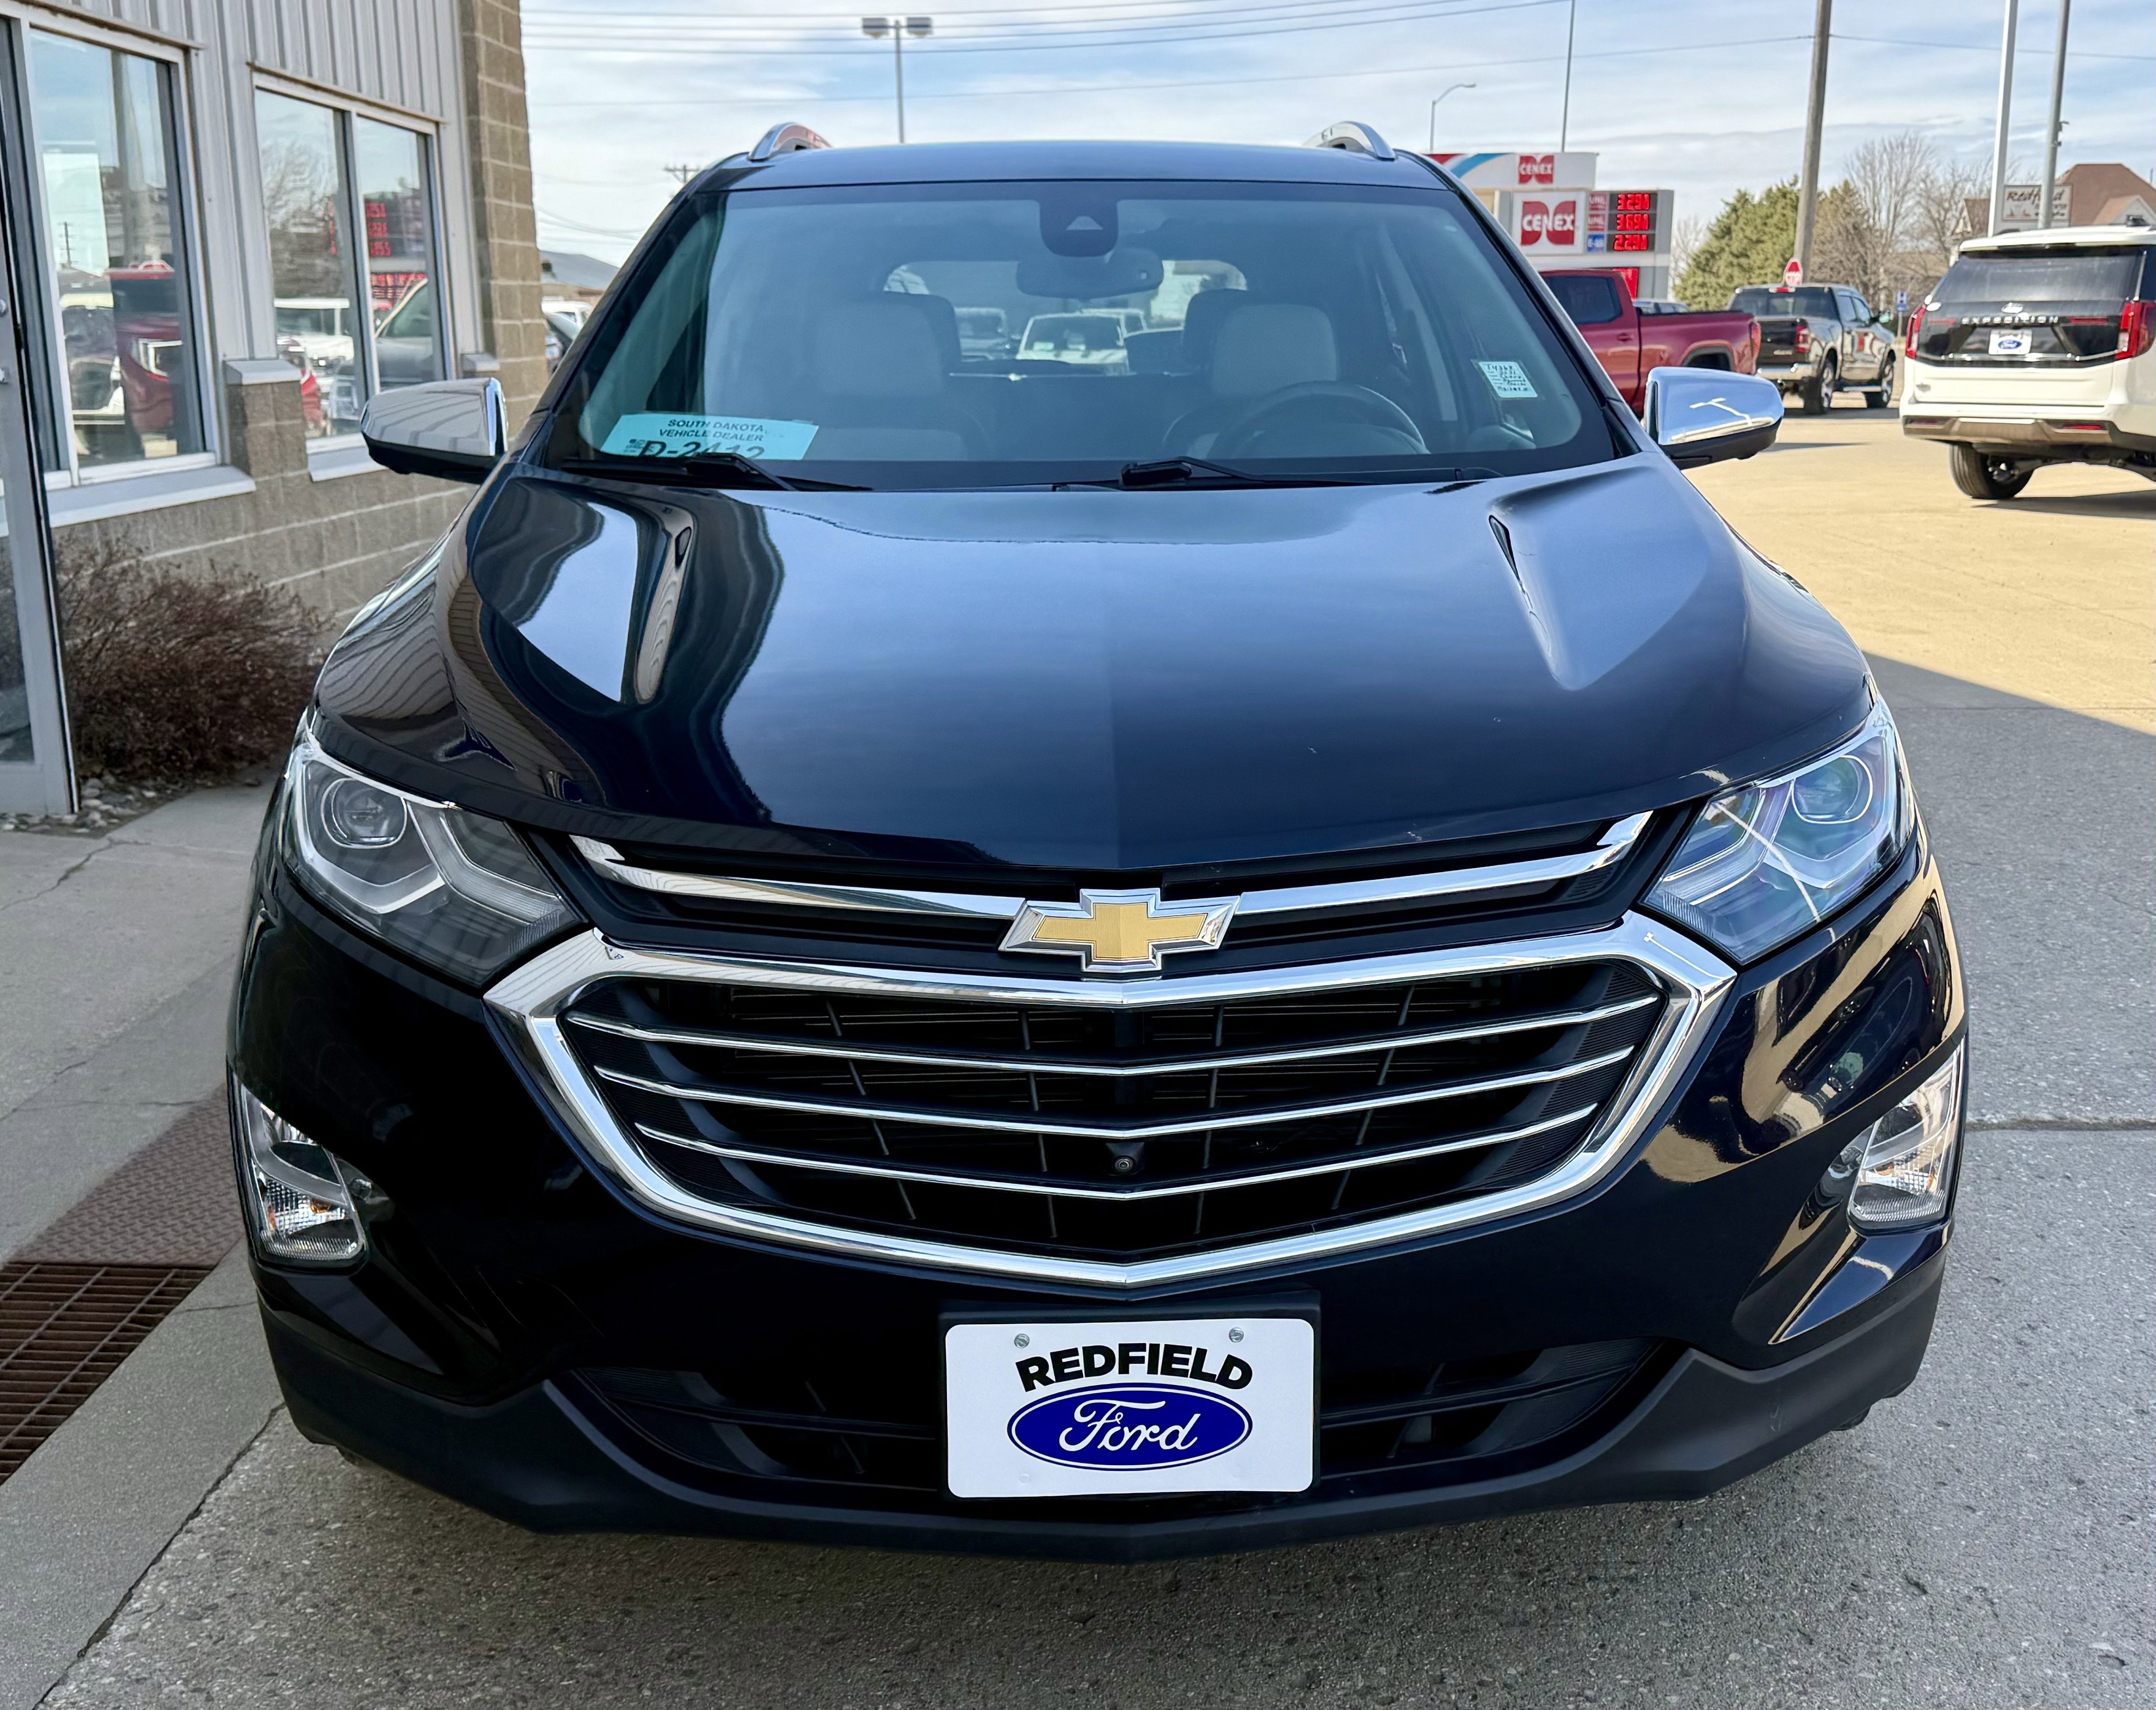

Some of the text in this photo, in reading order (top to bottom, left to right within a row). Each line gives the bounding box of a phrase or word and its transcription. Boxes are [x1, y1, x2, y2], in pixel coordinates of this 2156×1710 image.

[1519, 163, 1552, 175] CENEX
[1523, 215, 1574, 231] CENEX
[1962, 316, 2059, 325] EXPEDIION
[668, 419, 710, 428] SOUTH
[660, 429, 764, 442] VEHICLE DEALER
[1016, 1343, 1253, 1392] REDFIELD
[1059, 1399, 1201, 1451] Ford
